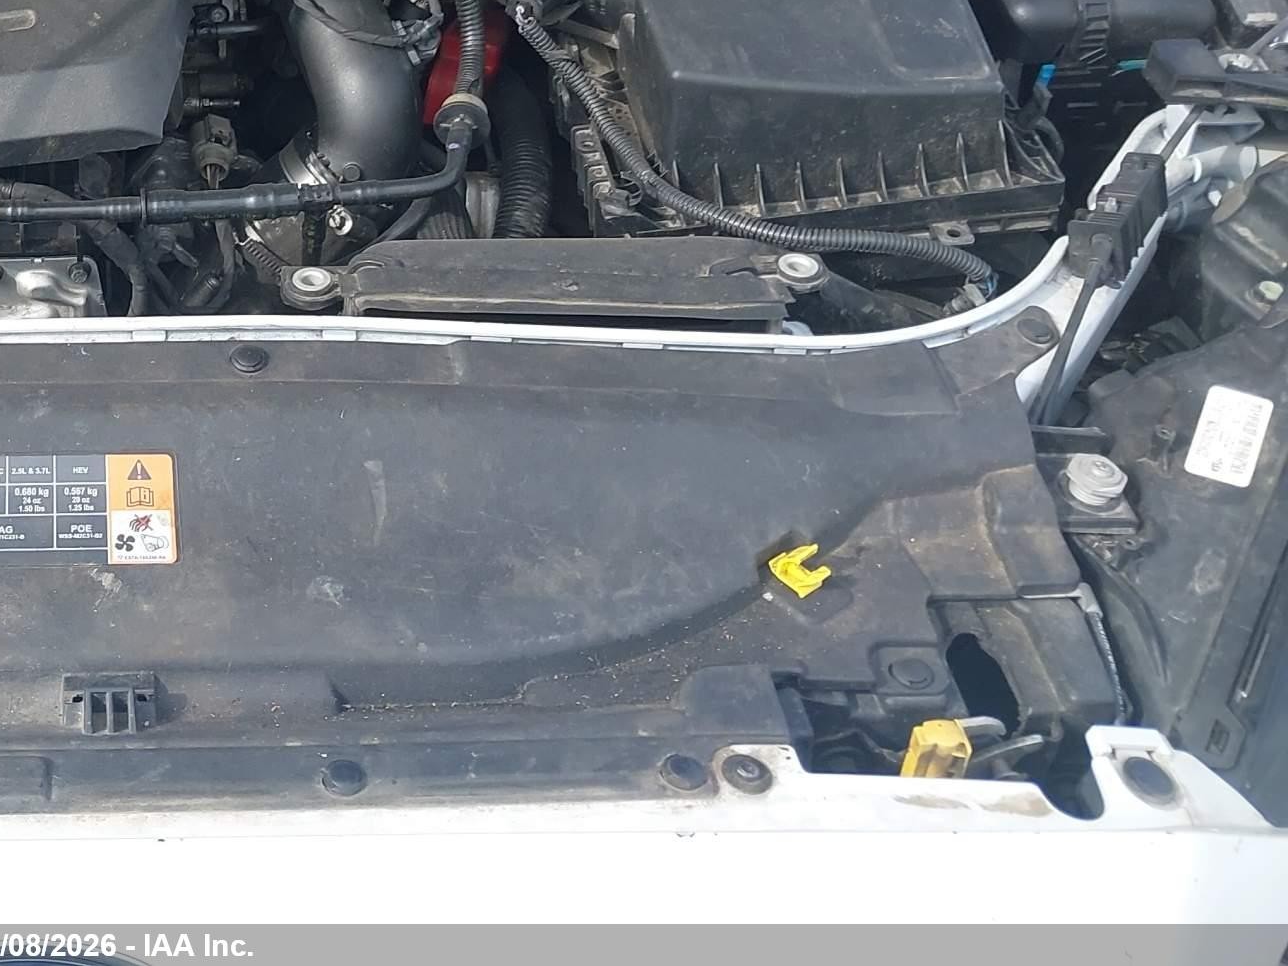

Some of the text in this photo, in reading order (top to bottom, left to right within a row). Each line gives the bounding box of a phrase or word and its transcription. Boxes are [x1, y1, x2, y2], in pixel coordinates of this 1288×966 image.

[14, 487, 49, 497] 0.680 kg
[87, 487, 98, 497] kg
[70, 524, 92, 532] POE
